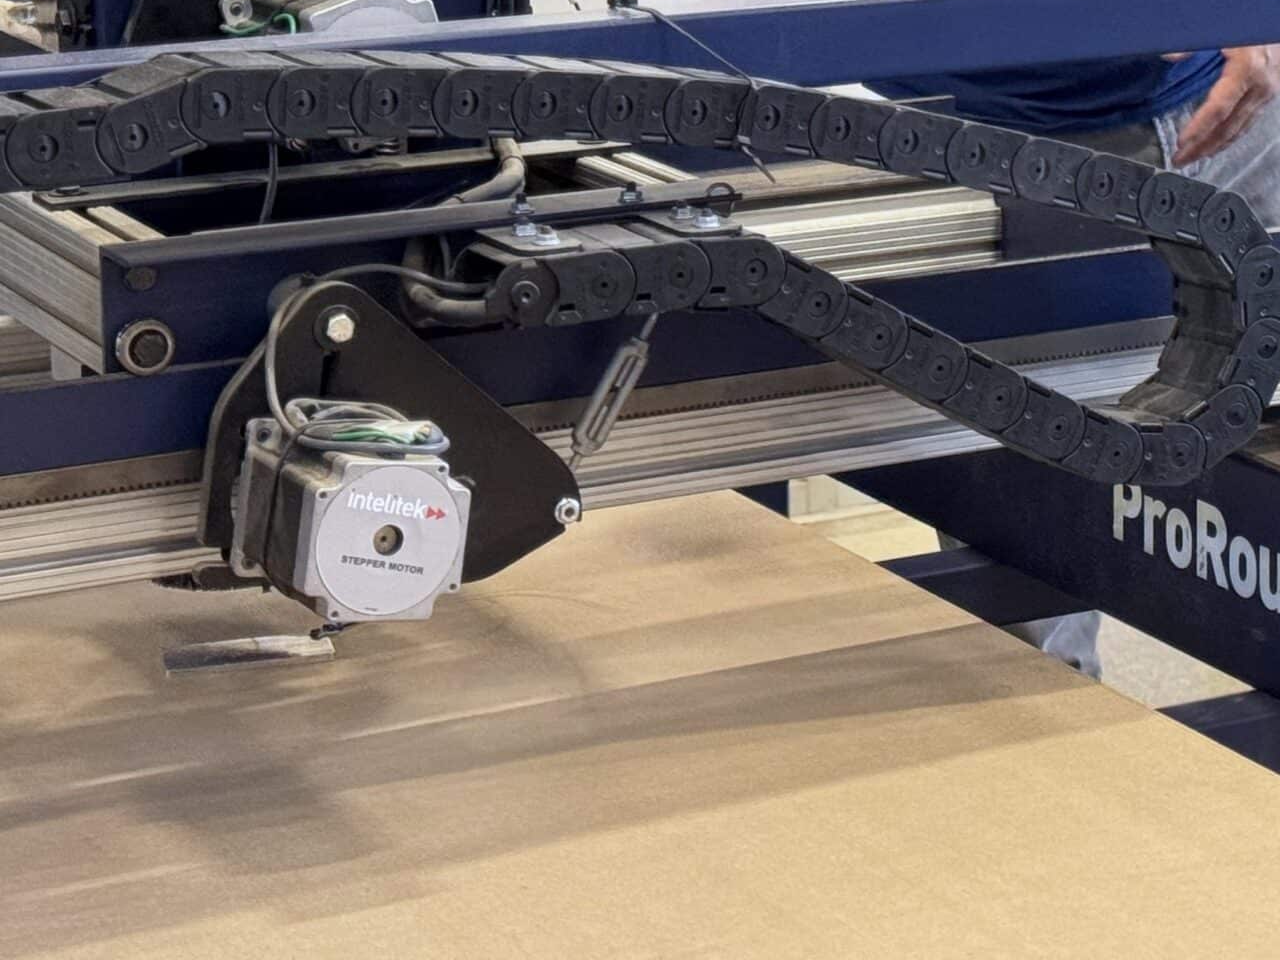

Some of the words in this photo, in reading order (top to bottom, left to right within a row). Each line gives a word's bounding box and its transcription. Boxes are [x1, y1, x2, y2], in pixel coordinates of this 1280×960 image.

[347, 489, 427, 520] intelitek
[340, 554, 386, 569] STEPPER
[388, 562, 424, 575] MOTOR
